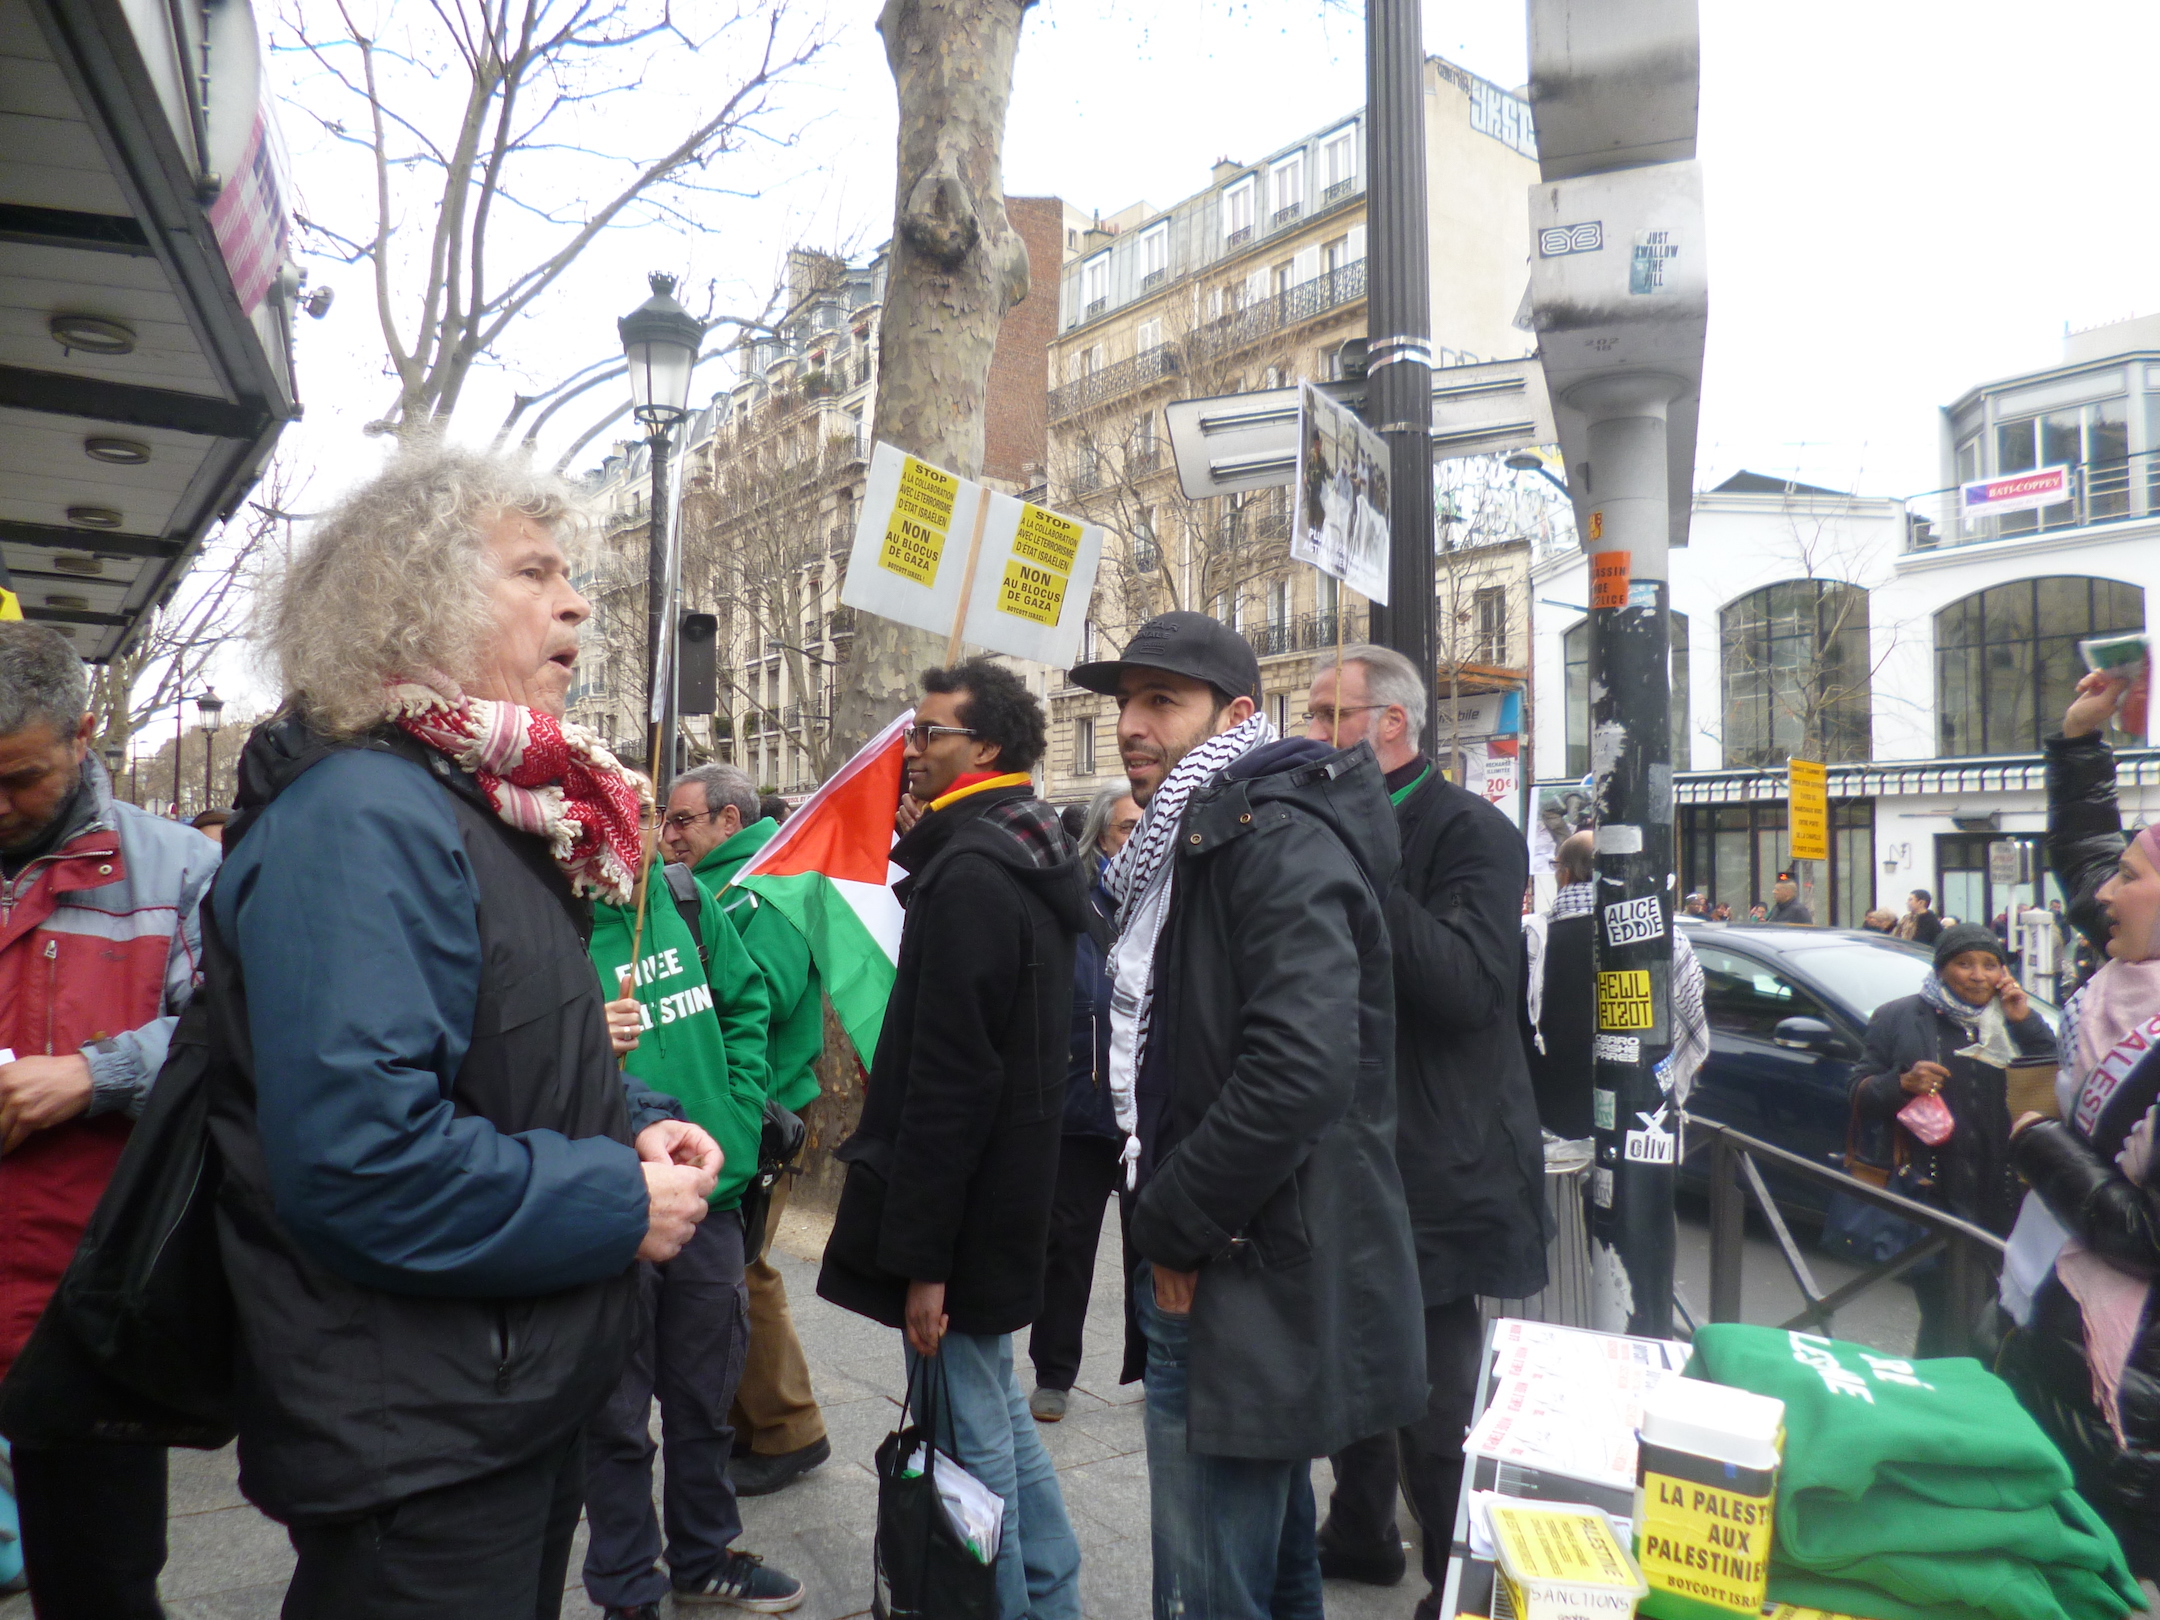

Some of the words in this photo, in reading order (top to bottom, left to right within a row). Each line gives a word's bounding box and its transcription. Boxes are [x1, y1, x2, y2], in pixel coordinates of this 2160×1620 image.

[1647, 232, 1669, 244] JUST
[1635, 245, 1678, 258] SWALLOW
[1648, 260, 1663, 272] THE
[1644, 274, 1663, 287] PILL
[915, 464, 947, 483] STOP
[899, 483, 914, 497] AVEC
[915, 477, 955, 501] COLLABORATION
[1036, 511, 1070, 530] STOP
[901, 520, 931, 544] NON
[1017, 528, 1033, 542] AVEC
[1034, 523, 1078, 547] COLLABORATION
[885, 531, 900, 544] AU
[902, 538, 939, 561] BLOCUS
[887, 561, 907, 576] BOYCOTT
[889, 545, 901, 558] DE
[904, 552, 929, 571] GAZA
[1020, 566, 1051, 586] NON
[1003, 577, 1018, 589] AU
[1021, 582, 1060, 603] BLOCUS
[1007, 590, 1021, 602] DE
[1024, 595, 1051, 612] GAZA
[1007, 605, 1028, 617] BOYCOTT
[1438, 708, 1479, 723] mbile
[1487, 778, 1512, 793] 20€
[1608, 897, 1657, 925] ALICE
[1609, 915, 1662, 943] EDDIE
[615, 948, 683, 987] FREE
[1660, 1482, 1684, 1507] LA
[1708, 1523, 1750, 1553] AUX
[1668, 1576, 1727, 1601] BOYCOTT
[1531, 1588, 1629, 1612] SANCTIONS
